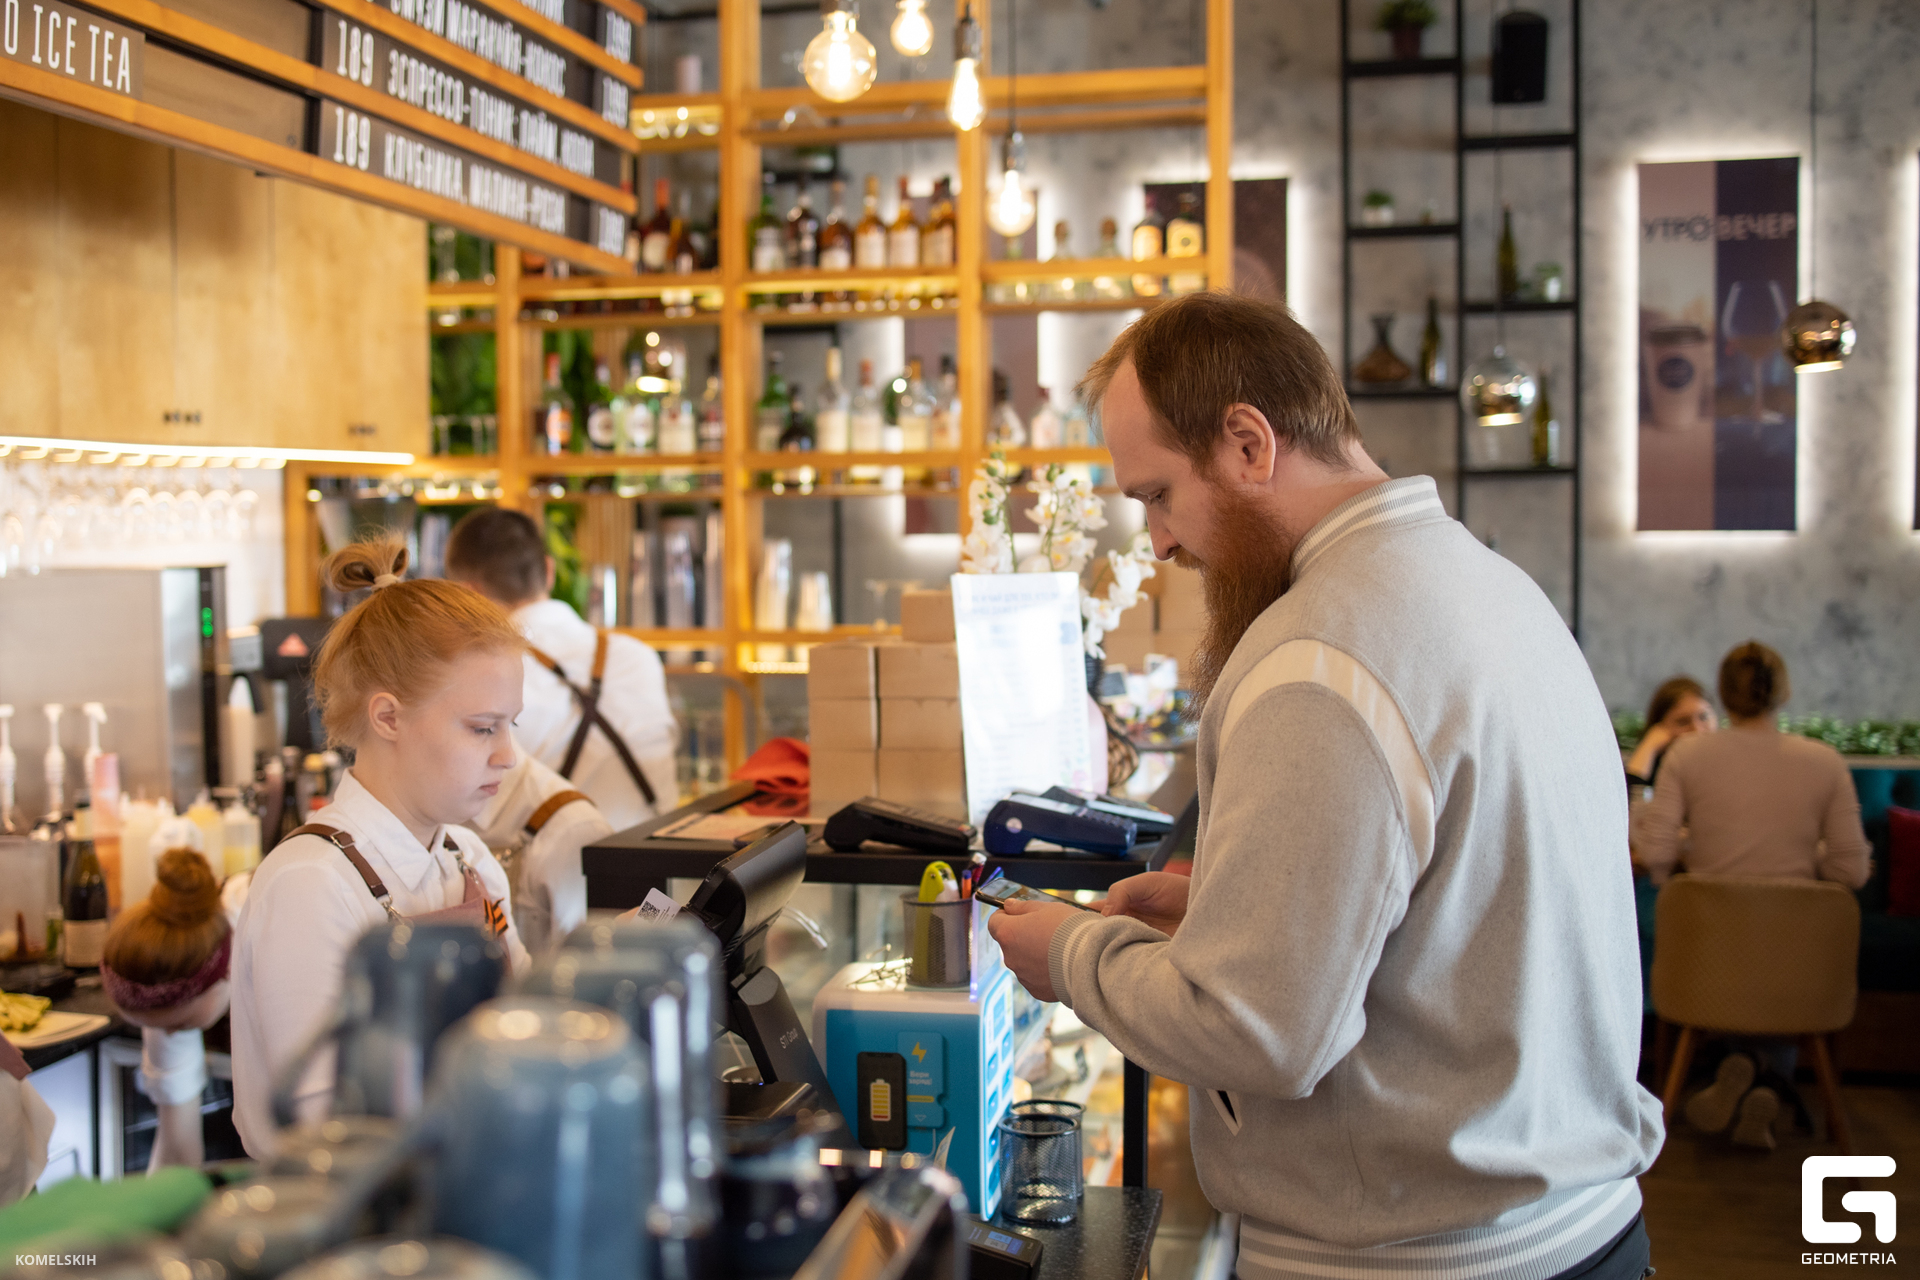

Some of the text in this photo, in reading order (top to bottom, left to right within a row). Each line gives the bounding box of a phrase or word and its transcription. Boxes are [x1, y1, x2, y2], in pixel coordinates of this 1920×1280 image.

[32, 4, 78, 75] ICE
[88, 24, 131, 94] TEA
[337, 20, 374, 87] 189
[333, 106, 371, 171] 189
[1643, 214, 1712, 244] УТРО
[1716, 211, 1797, 241] ВЕЧЕР
